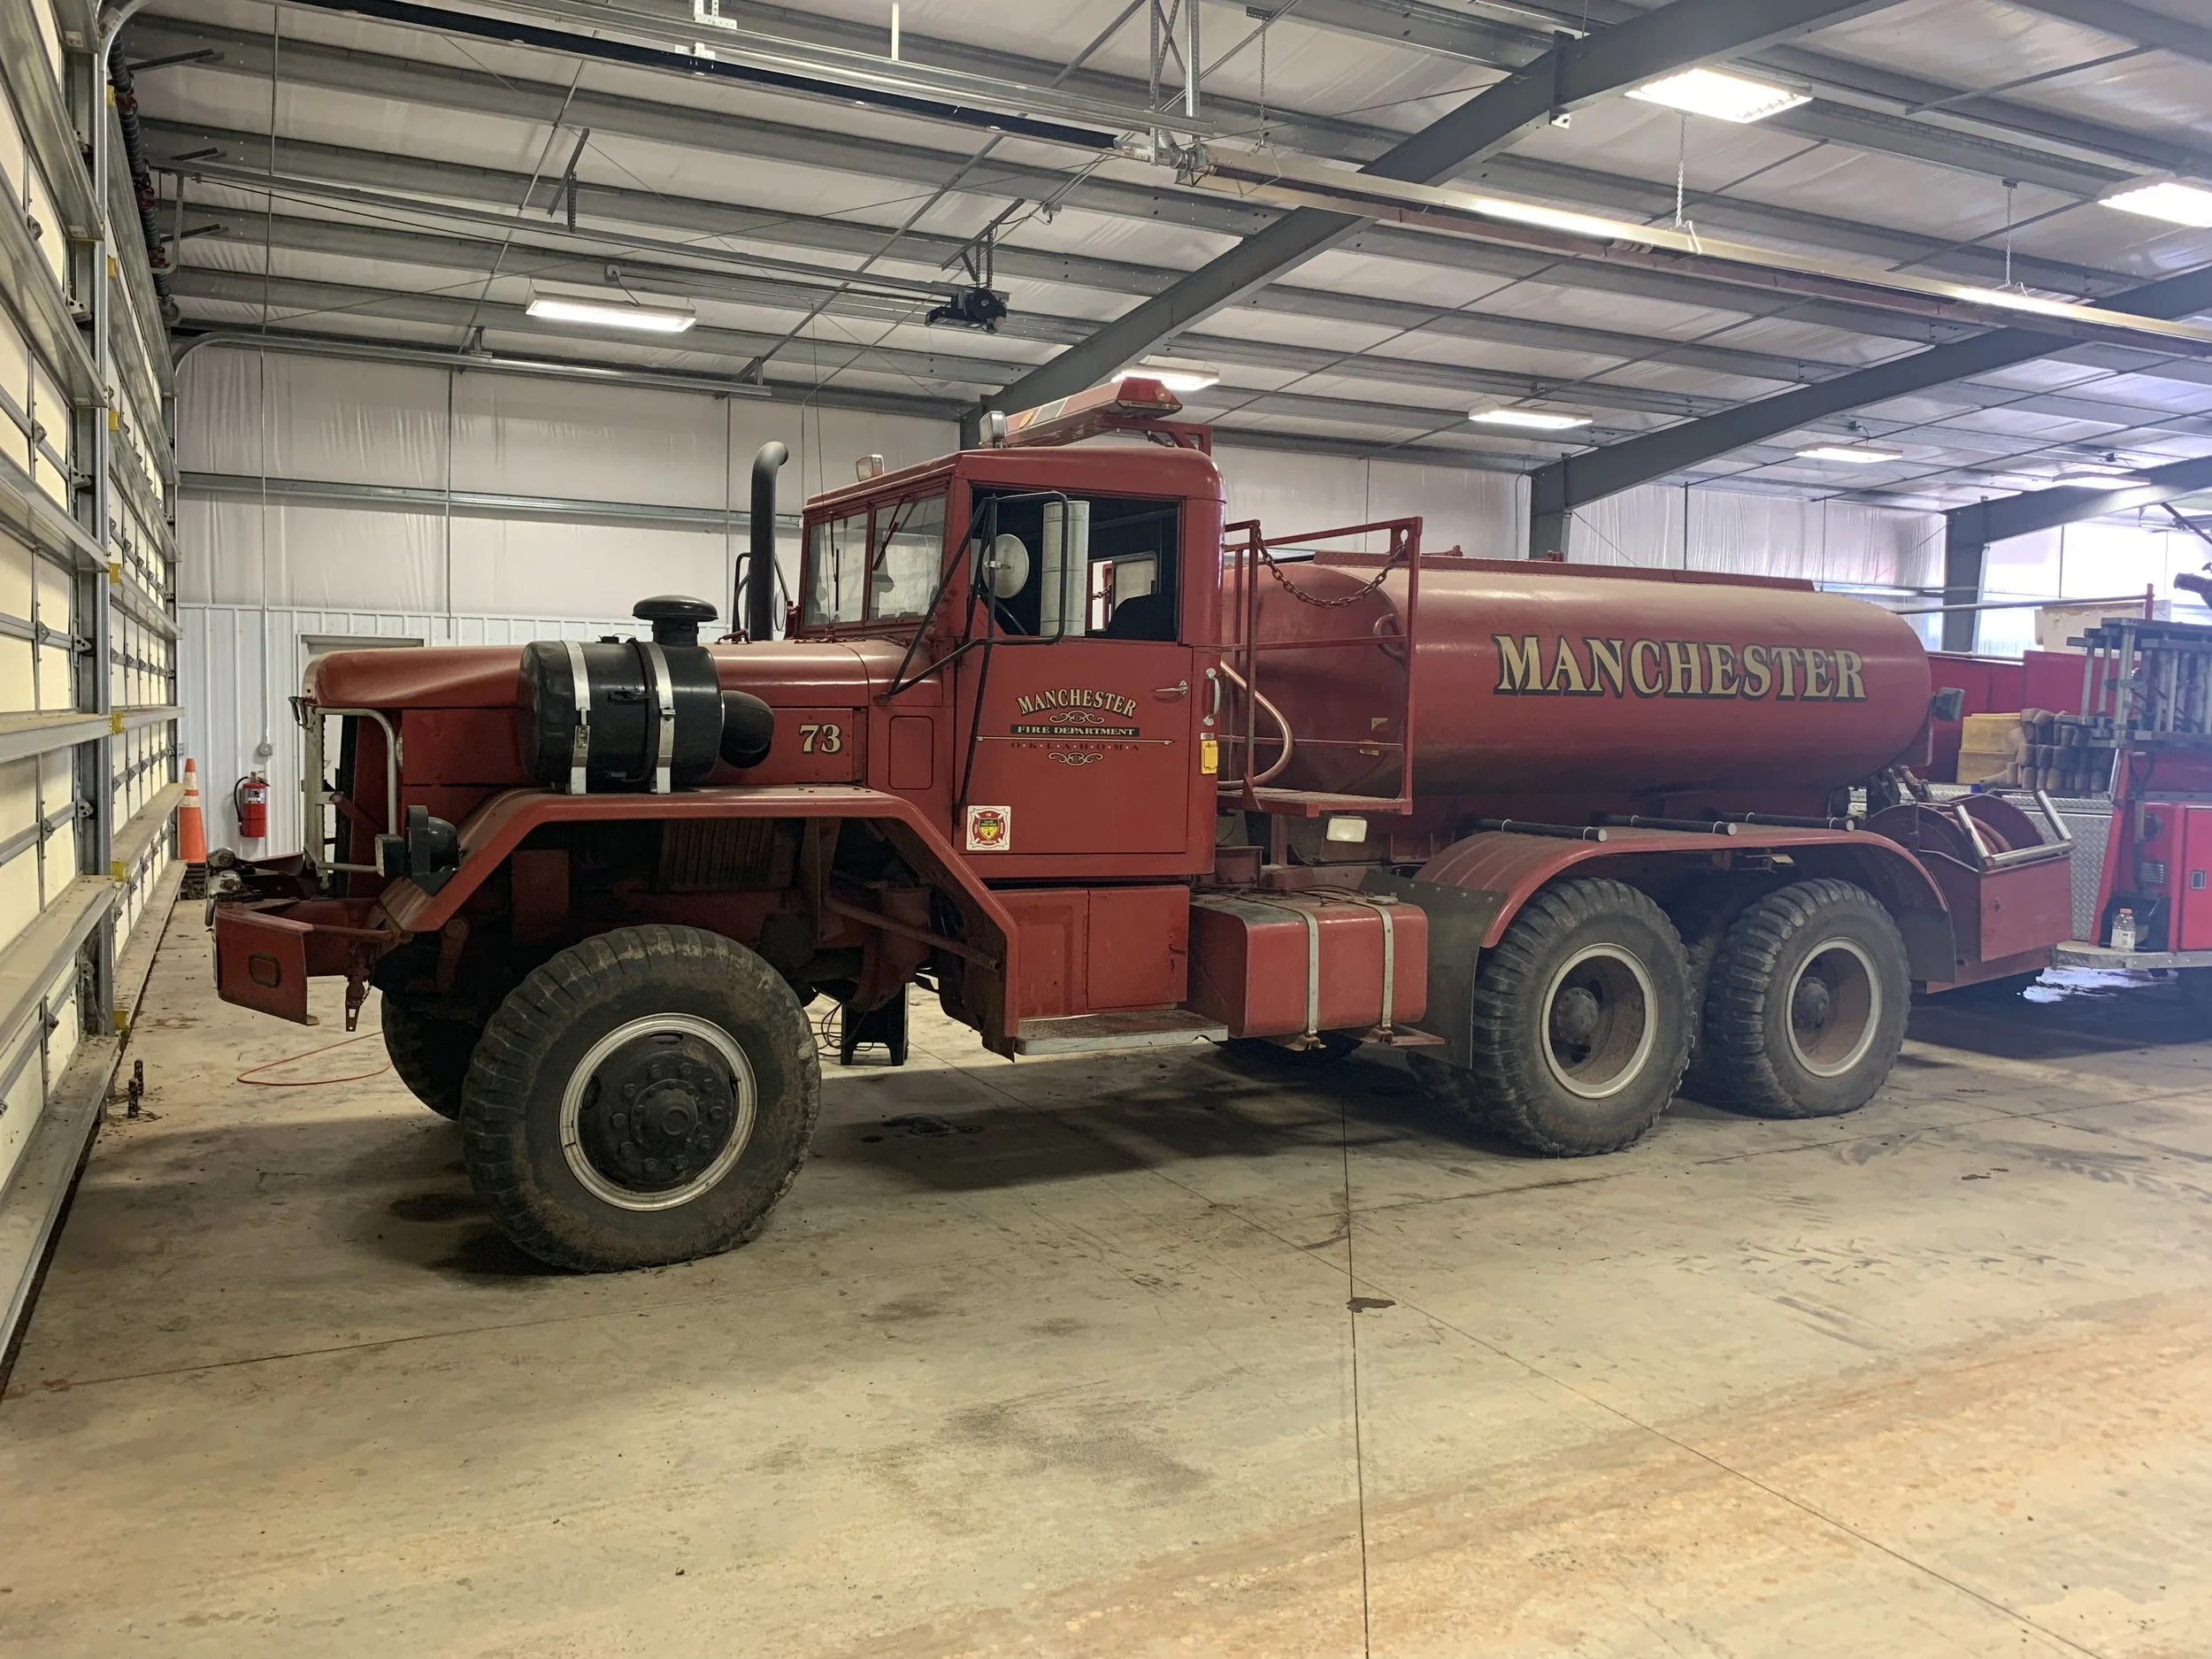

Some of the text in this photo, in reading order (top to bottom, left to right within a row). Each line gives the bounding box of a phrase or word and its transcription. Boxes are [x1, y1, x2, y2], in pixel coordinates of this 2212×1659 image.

[1491, 633, 1868, 701] MANCHESTER
[1016, 688, 1138, 718] MANCHESTER
[799, 723, 842, 754] 73
[1054, 726, 1135, 735] DEPARTMENT
